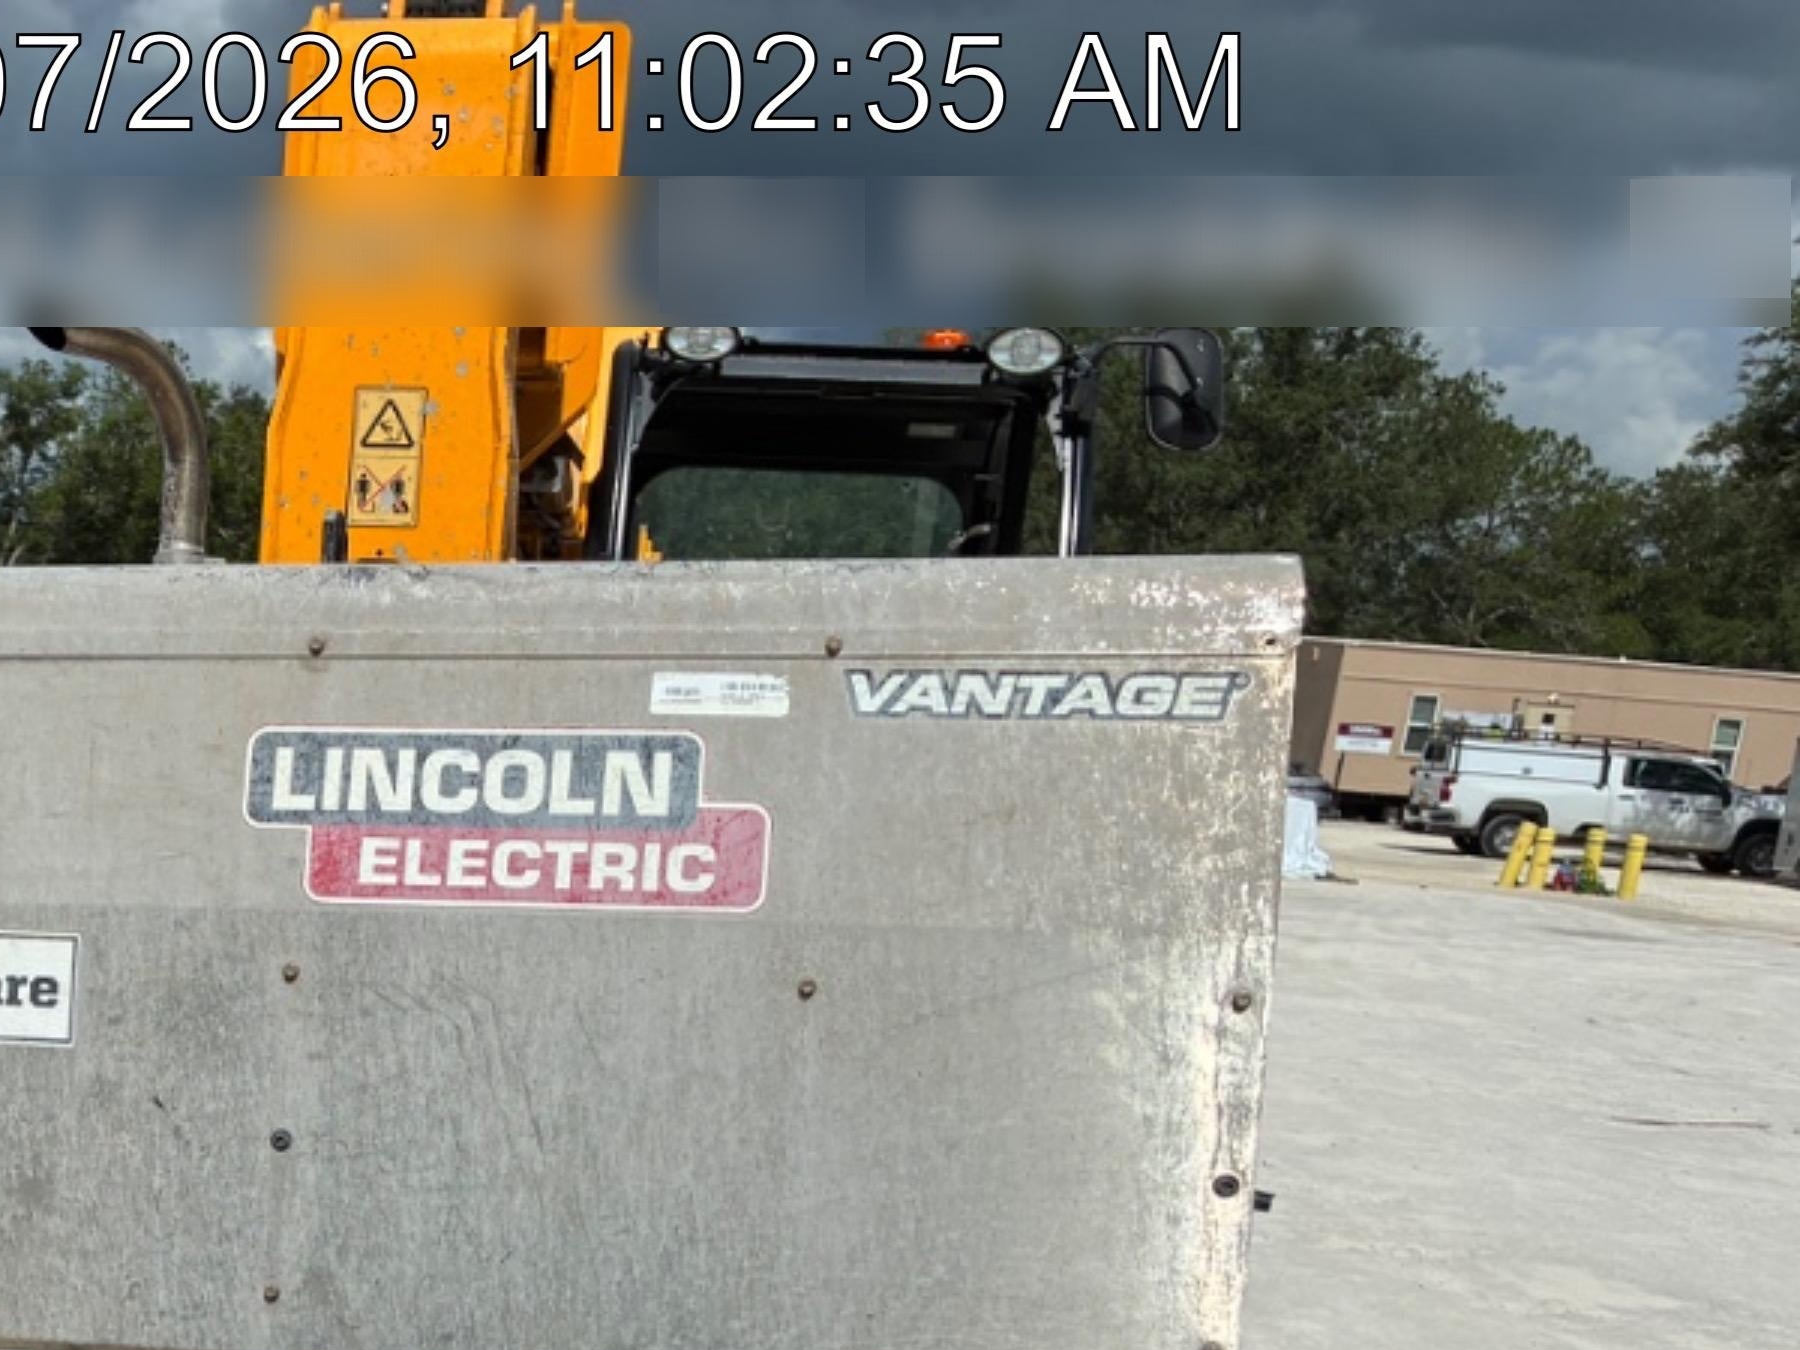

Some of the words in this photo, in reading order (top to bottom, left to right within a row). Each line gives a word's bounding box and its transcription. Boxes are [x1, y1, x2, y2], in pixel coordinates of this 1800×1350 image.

[847, 670, 1235, 718] VANTAGE
[271, 745, 674, 818] LINCOLN
[357, 836, 718, 893] ELECTRIC
